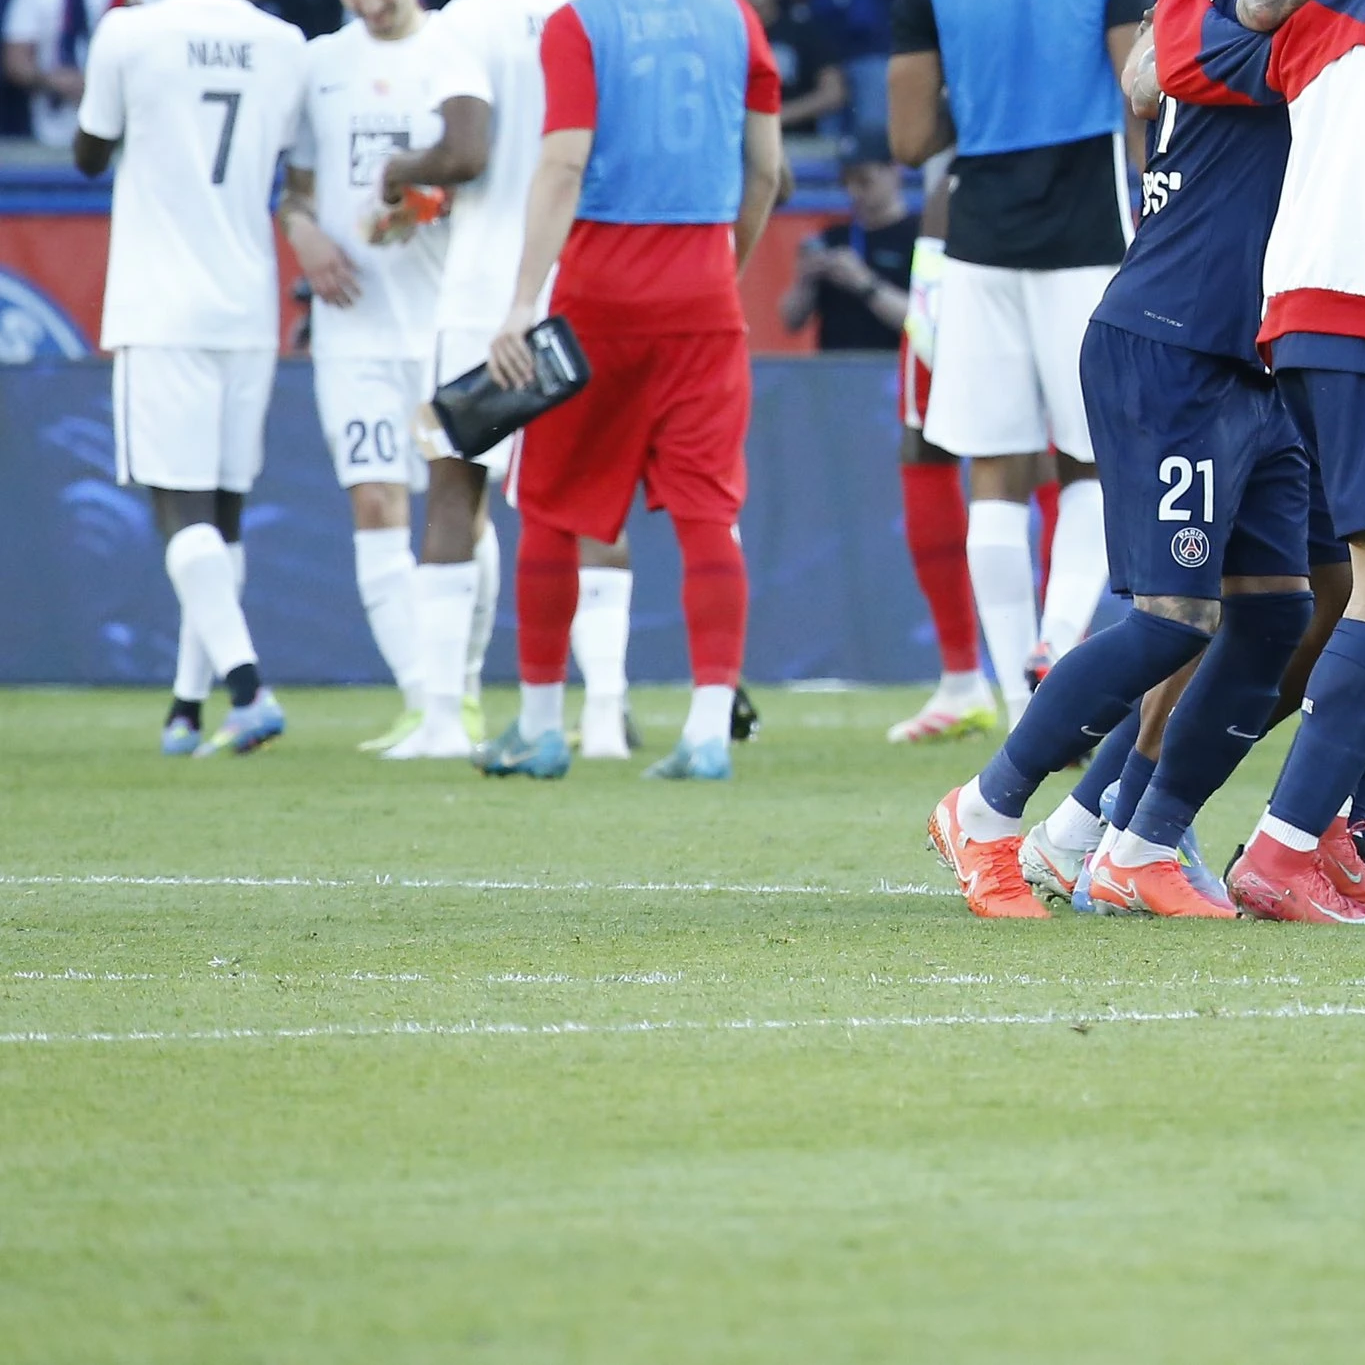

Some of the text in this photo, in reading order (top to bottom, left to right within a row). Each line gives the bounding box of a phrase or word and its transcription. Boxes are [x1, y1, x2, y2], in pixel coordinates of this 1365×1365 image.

[202, 91, 241, 184] 7
[347, 420, 396, 464] 20
[1158, 455, 1213, 523] 21
